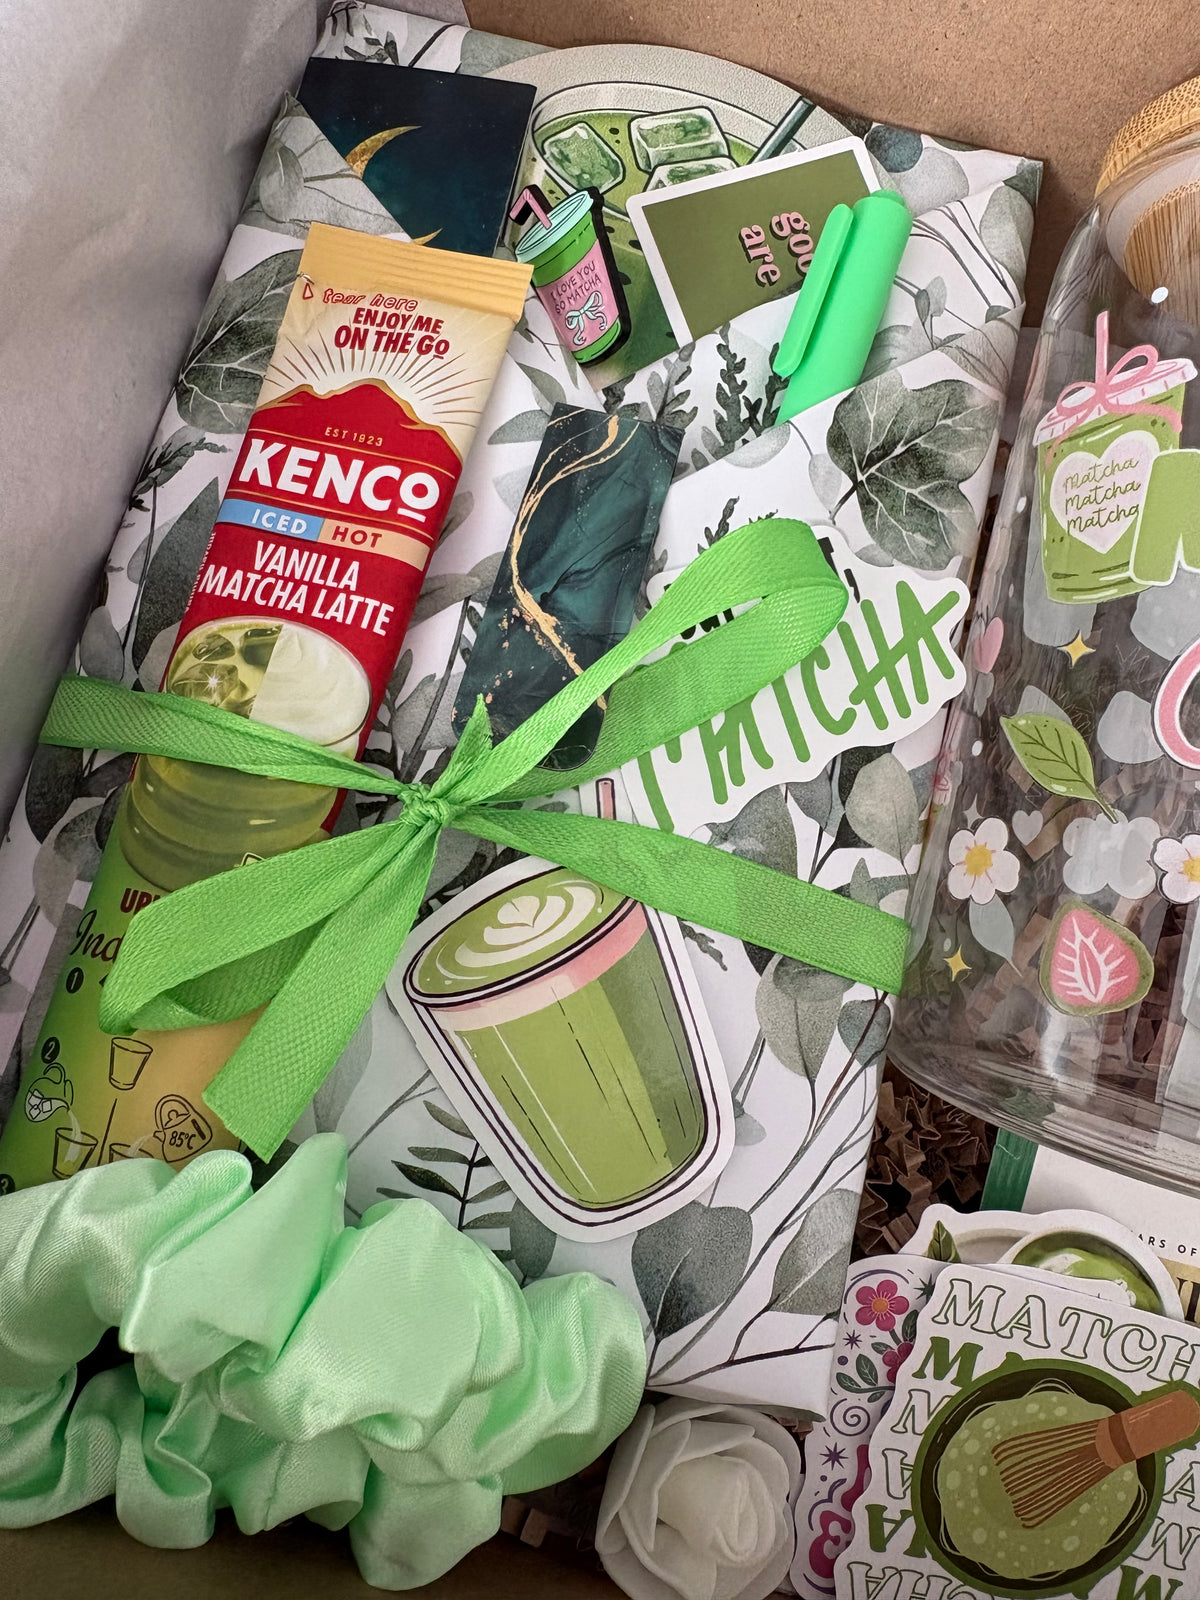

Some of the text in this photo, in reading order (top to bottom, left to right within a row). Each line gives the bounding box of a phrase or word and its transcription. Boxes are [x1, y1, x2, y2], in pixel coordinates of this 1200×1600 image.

[738, 224, 781, 287] are
[322, 288, 418, 312] tear here
[550, 260, 596, 301] I LOVE YOU
[555, 273, 602, 314] SO MATCHA
[334, 325, 369, 351] ON
[372, 330, 415, 353] THE
[352, 307, 445, 335] ENJOY ME
[325, 427, 384, 447] EST 1923
[238, 438, 440, 523] KENCO
[251, 508, 383, 548] ICED HOT
[253, 540, 360, 592] VANILLA
[197, 564, 308, 614] MATCHA
[311, 589, 394, 637] LATTE
[169, 1130, 196, 1150] 85°C
[1177, 1244, 1197, 1257] OF
